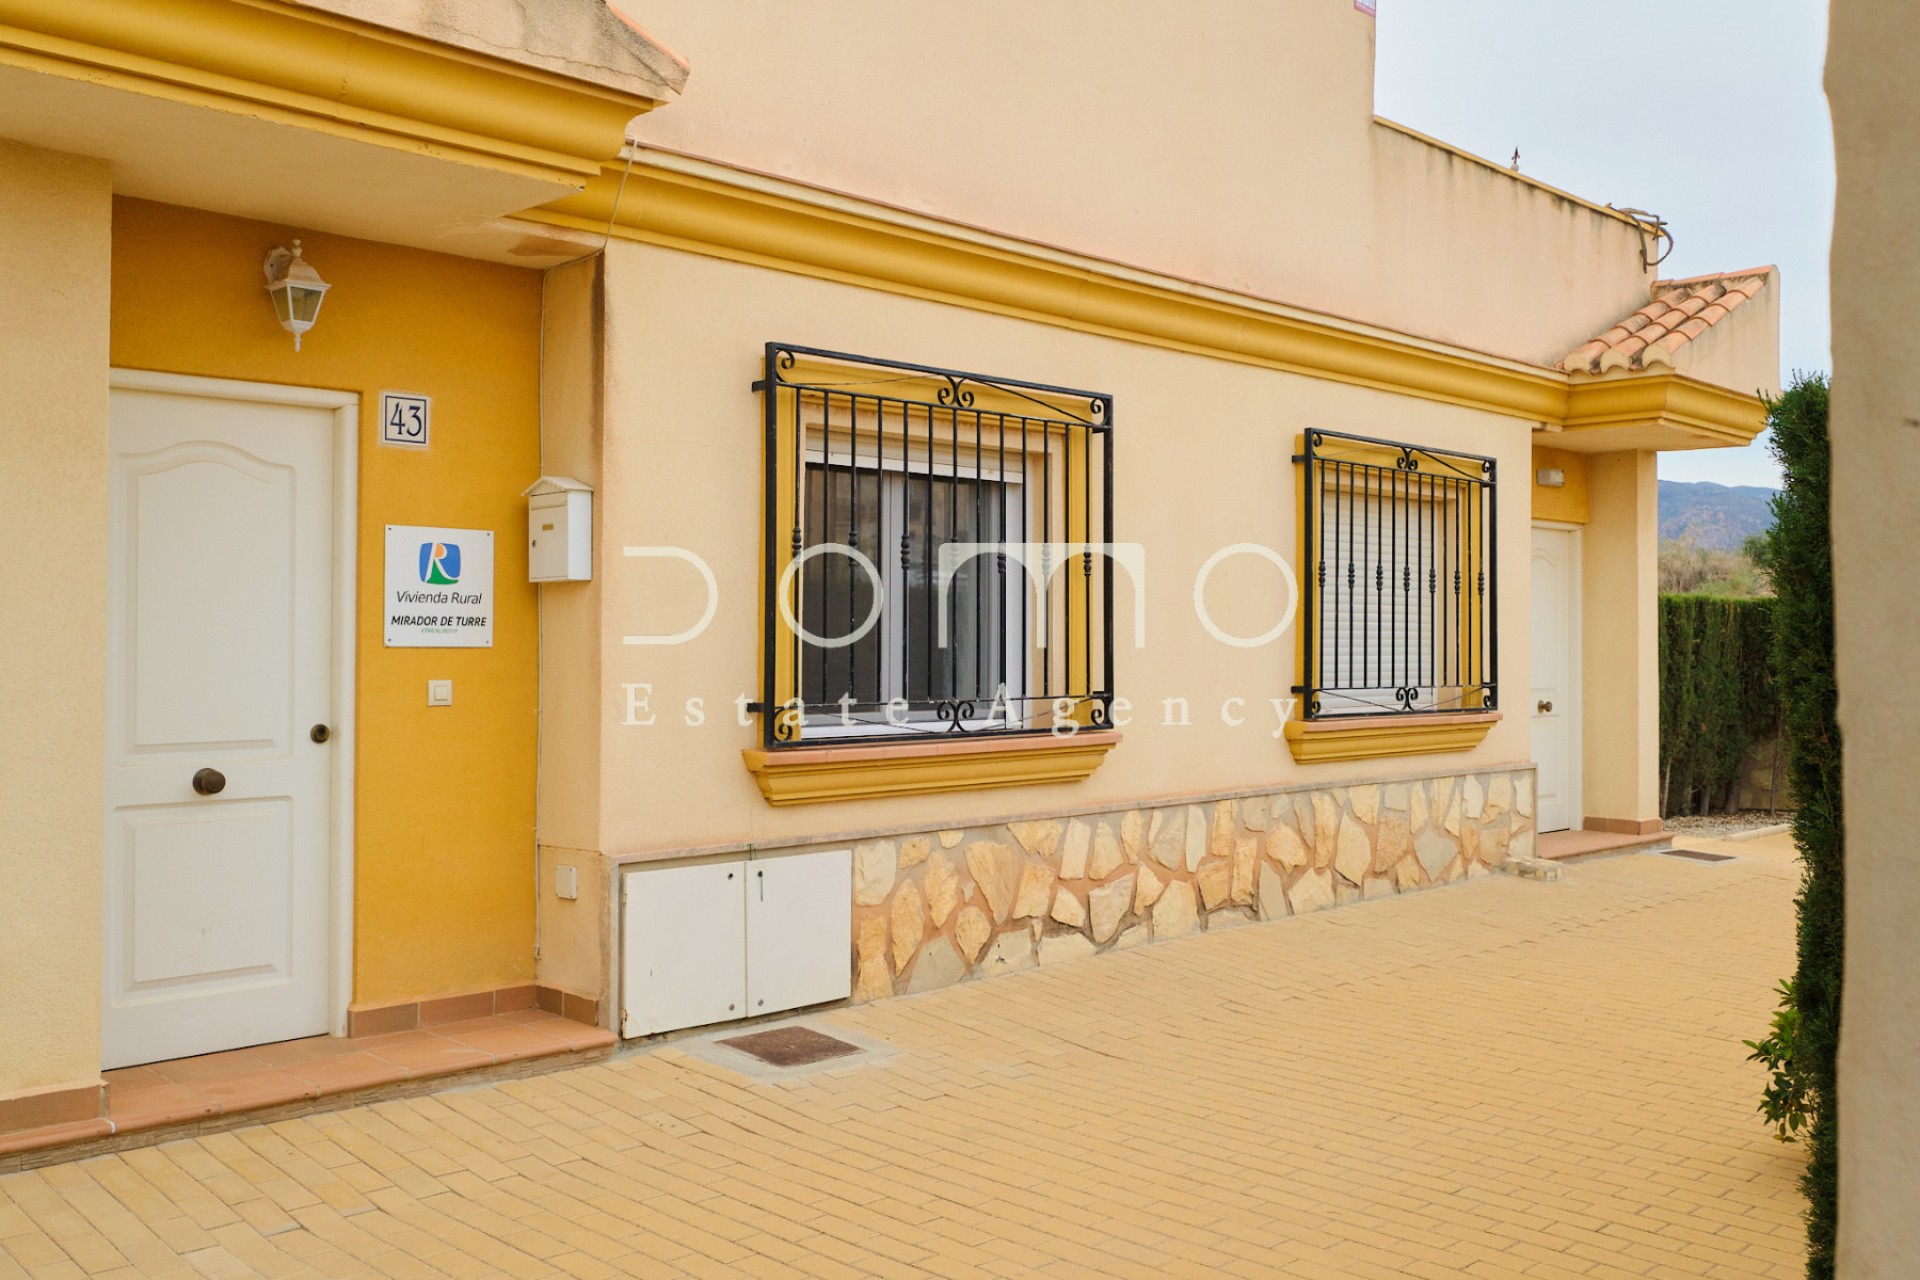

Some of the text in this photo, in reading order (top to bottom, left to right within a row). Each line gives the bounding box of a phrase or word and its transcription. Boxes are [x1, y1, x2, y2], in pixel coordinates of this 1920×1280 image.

[390, 402, 422, 437] 43
[397, 590, 483, 605] Vivienda Rural
[391, 615, 487, 627] MIRADOR DE TURRE
